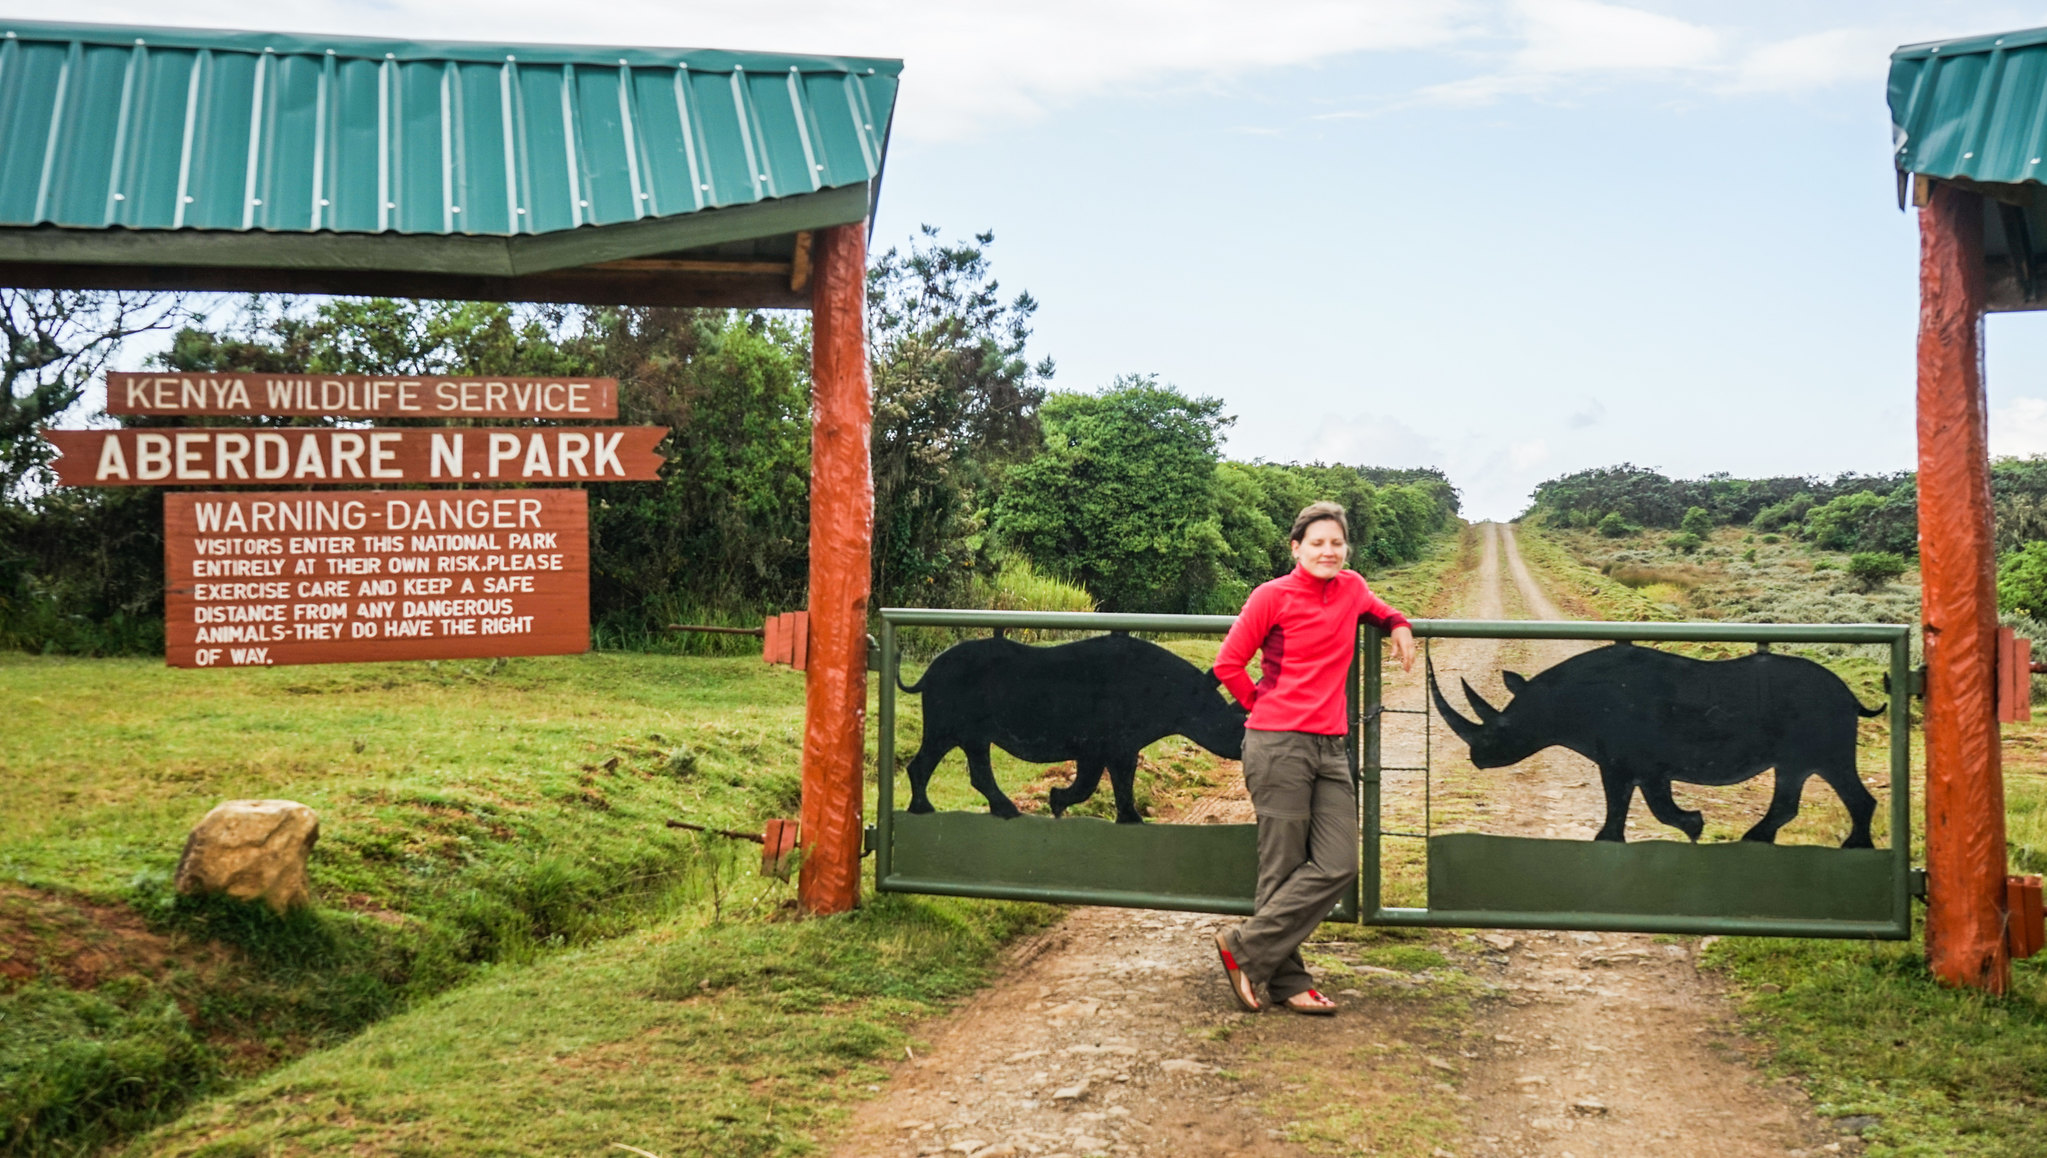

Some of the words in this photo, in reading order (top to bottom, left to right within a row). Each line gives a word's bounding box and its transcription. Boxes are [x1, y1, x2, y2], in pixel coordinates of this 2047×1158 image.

[127, 377, 251, 410] KENYA
[266, 379, 422, 411] WILDLIFE
[435, 381, 591, 413] SERVICE
[95, 432, 404, 481] ABERDARE
[194, 498, 543, 532] WARNING-DANGER
[194, 537, 284, 556] VISITORS
[289, 536, 356, 555] ENTER
[361, 535, 405, 553] THIS
[411, 533, 501, 552] NATIONAL
[508, 532, 558, 550] PARK
[193, 558, 286, 577] ENTIRELY
[294, 558, 317, 575] AT
[325, 557, 382, 575] THEIR
[387, 556, 430, 574] OWN
[194, 581, 291, 601] EXERCISE
[297, 580, 351, 598] CARE
[357, 579, 398, 597] AND
[403, 577, 453, 596] KEEP
[459, 577, 476, 594] A
[482, 575, 535, 594] SAFE
[194, 604, 288, 624] DISTANCE
[293, 602, 348, 621] FROM
[356, 600, 396, 619] ANY
[402, 598, 514, 617] DANGEROUS
[194, 623, 344, 643] ANIMALS-THEY
[351, 621, 378, 639] DO
[384, 619, 434, 638] HAVE
[439, 618, 477, 636] THE
[481, 615, 535, 635] RIGHT
[195, 648, 223, 666] OF
[230, 647, 274, 665] WAY.
